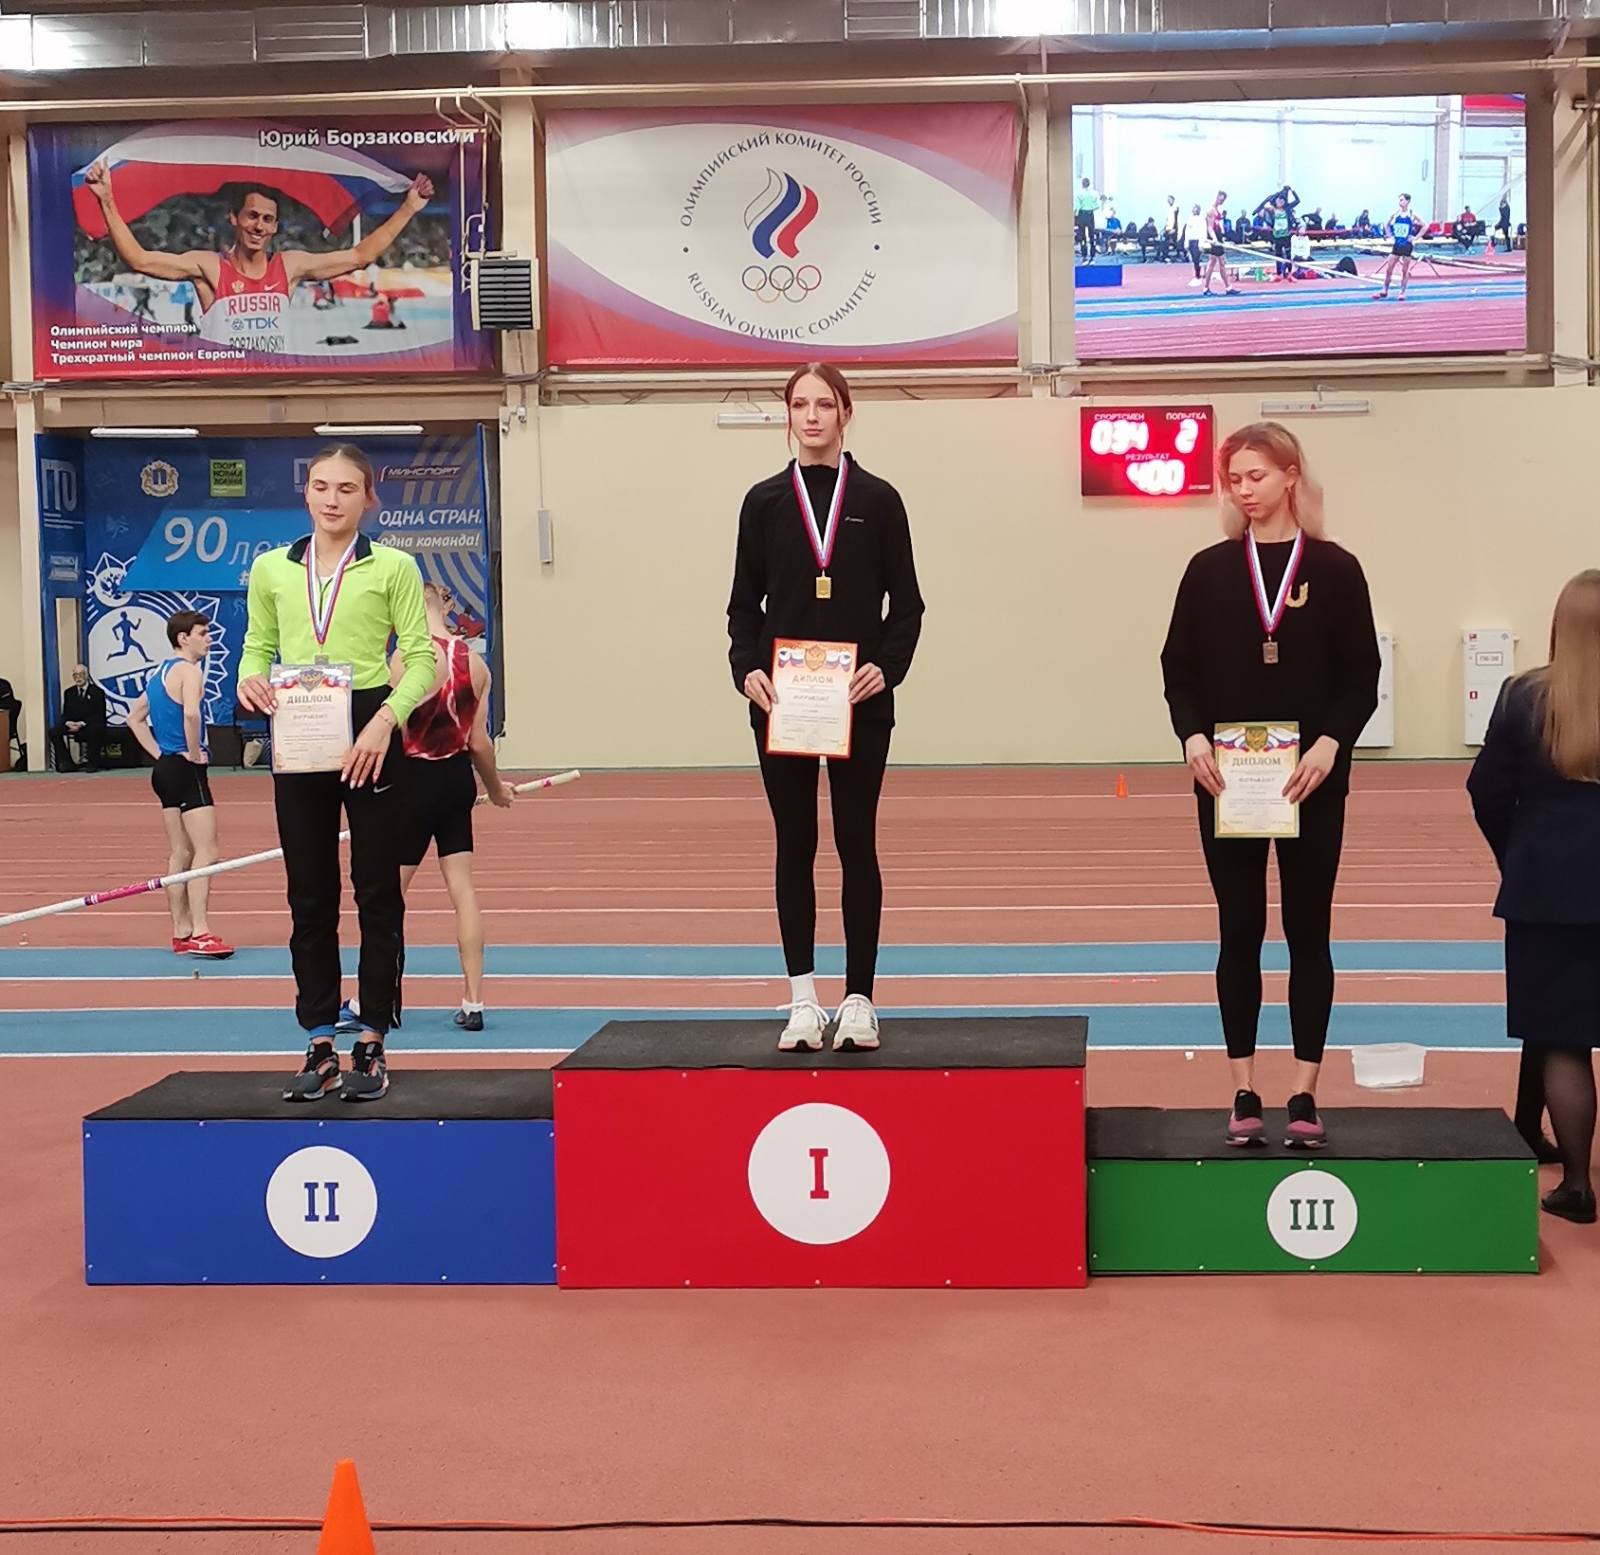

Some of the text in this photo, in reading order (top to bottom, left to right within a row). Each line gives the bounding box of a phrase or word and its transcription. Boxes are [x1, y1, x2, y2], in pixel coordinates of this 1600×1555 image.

[260, 130, 320, 149] Юрий
[680, 131, 882, 227] ОЛИМПИЙСКИЙ КОМИТЕТ РОССИИ
[228, 295, 281, 316] RUSSIA
[688, 268, 876, 340] RUSSIAN OLYMPIC COMMITTEE
[50, 323, 197, 337] Олимпийский чемпион
[243, 316, 279, 330] TDK
[51, 338, 143, 352] Чемпион мира
[51, 349, 246, 365] Трехкратный чемпион Европы
[1165, 411, 1208, 421] ПОПЫТКА
[1174, 418, 1200, 454] 2
[1125, 458, 1186, 496] 400
[378, 508, 482, 527] ОДНА СТРАН
[164, 516, 228, 562] 90
[380, 534, 480, 548] одна команда!
[286, 694, 333, 705] ДИПЛОМ
[1231, 756, 1281, 767] ДИПЛОМ
[809, 1148, 829, 1199] I
[304, 1182, 340, 1222] II
[1289, 1199, 1335, 1231] III
